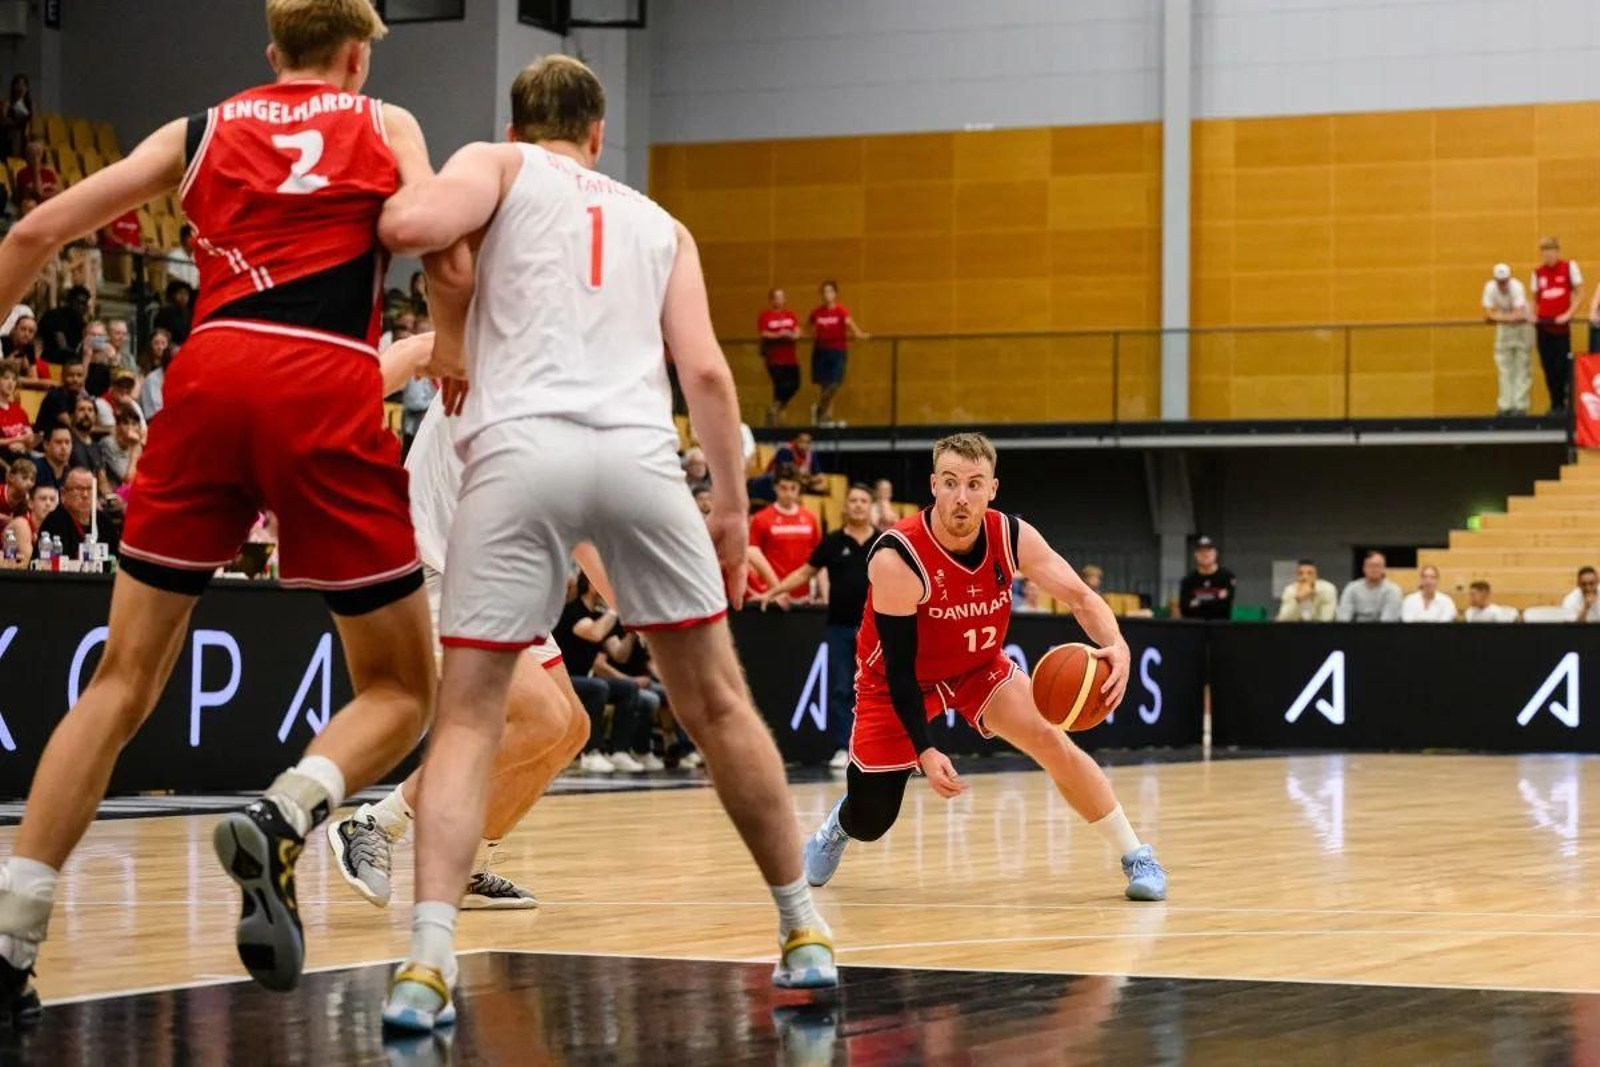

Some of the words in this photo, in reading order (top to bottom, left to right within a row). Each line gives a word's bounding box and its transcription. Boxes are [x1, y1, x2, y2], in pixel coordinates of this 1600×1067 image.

[222, 92, 367, 124] ENGELHARDT
[271, 129, 331, 195] 2
[586, 205, 604, 288] 1
[963, 626, 997, 653] 12
